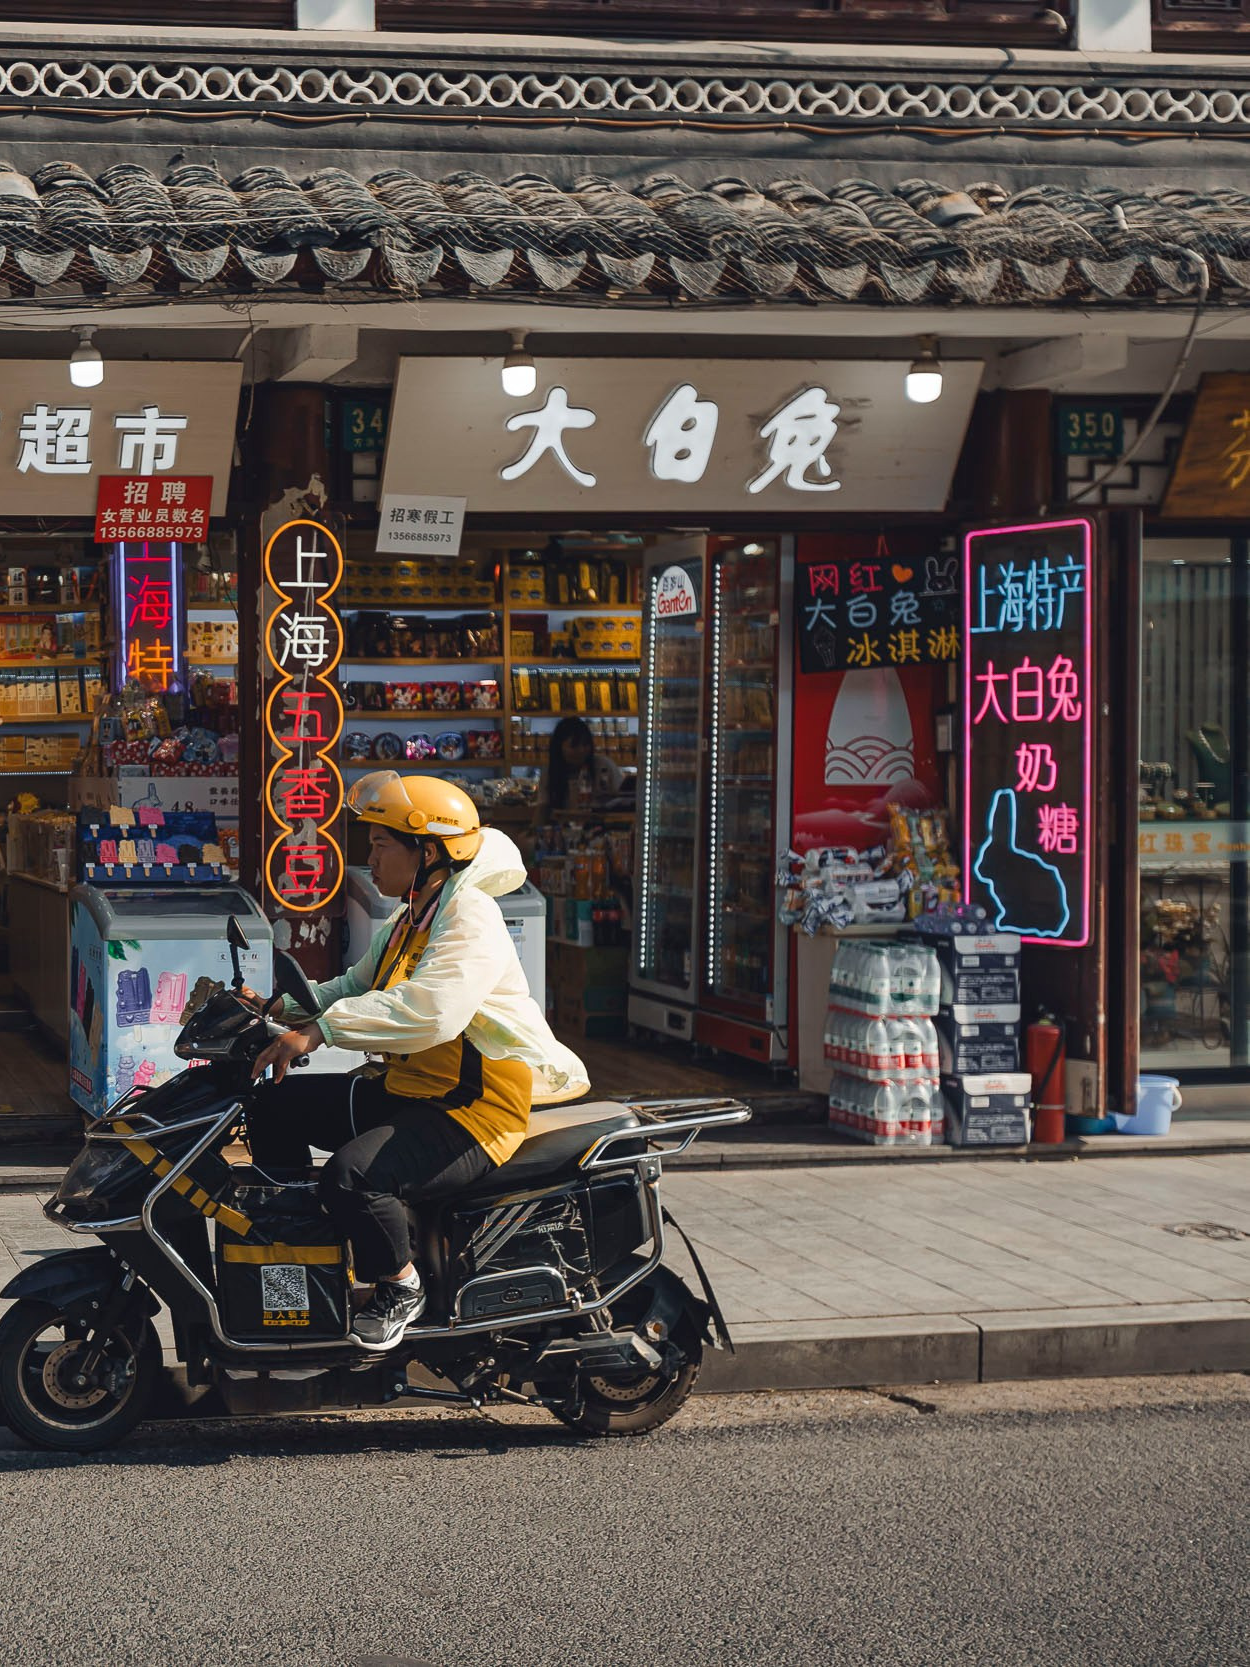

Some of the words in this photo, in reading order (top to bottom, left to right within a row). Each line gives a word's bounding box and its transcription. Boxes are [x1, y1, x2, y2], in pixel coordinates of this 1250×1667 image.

[499, 382, 841, 495] 大白兔
[1068, 411, 1115, 438] 350
[123, 481, 187, 505] 招聘
[100, 526, 203, 539] 13566885973
[101, 508, 206, 524] 女营业员数名
[389, 508, 455, 525] 招寒假工
[387, 531, 452, 543] 13566885973
[808, 562, 884, 597] 网红
[970, 553, 1086, 633] 上海特产
[805, 589, 921, 632] 大白兔
[846, 625, 961, 667] 冰淇淋
[973, 653, 1083, 725] 大白兔
[279, 535, 331, 894] 上海五香豆
